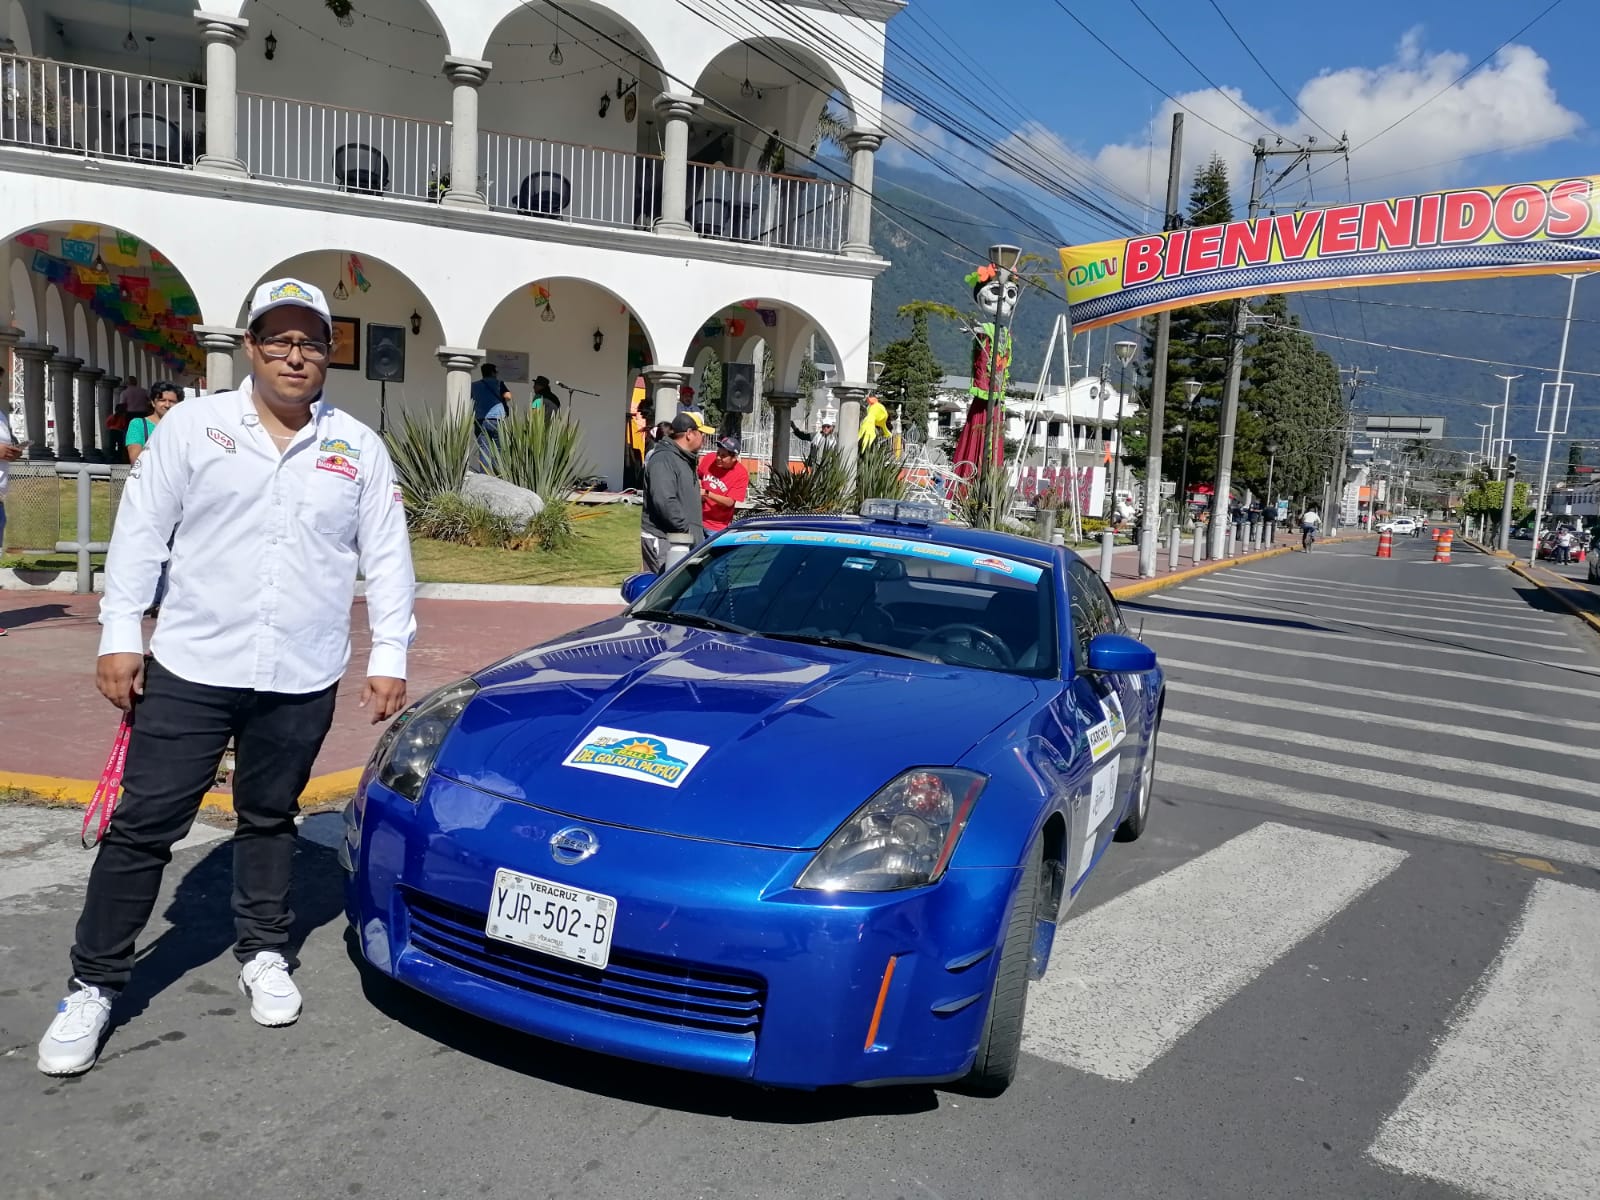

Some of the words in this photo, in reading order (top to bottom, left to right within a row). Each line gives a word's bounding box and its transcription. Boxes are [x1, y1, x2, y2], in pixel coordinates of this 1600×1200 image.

[1122, 180, 1592, 287] BIENVENIDOS
[210, 430, 232, 446] IUSA
[116, 745, 126, 773] NISSAN
[575, 748, 595, 762] DEL
[594, 752, 627, 766] GOLFO
[625, 759, 639, 769] AL
[637, 761, 681, 781] PACIFICO
[618, 749, 652, 759] RALLY
[105, 792, 116, 820] NISSAN
[553, 835, 591, 850] NISSAN
[530, 882, 578, 902] VERACRUZ
[497, 887, 607, 944] YJR-502-B
